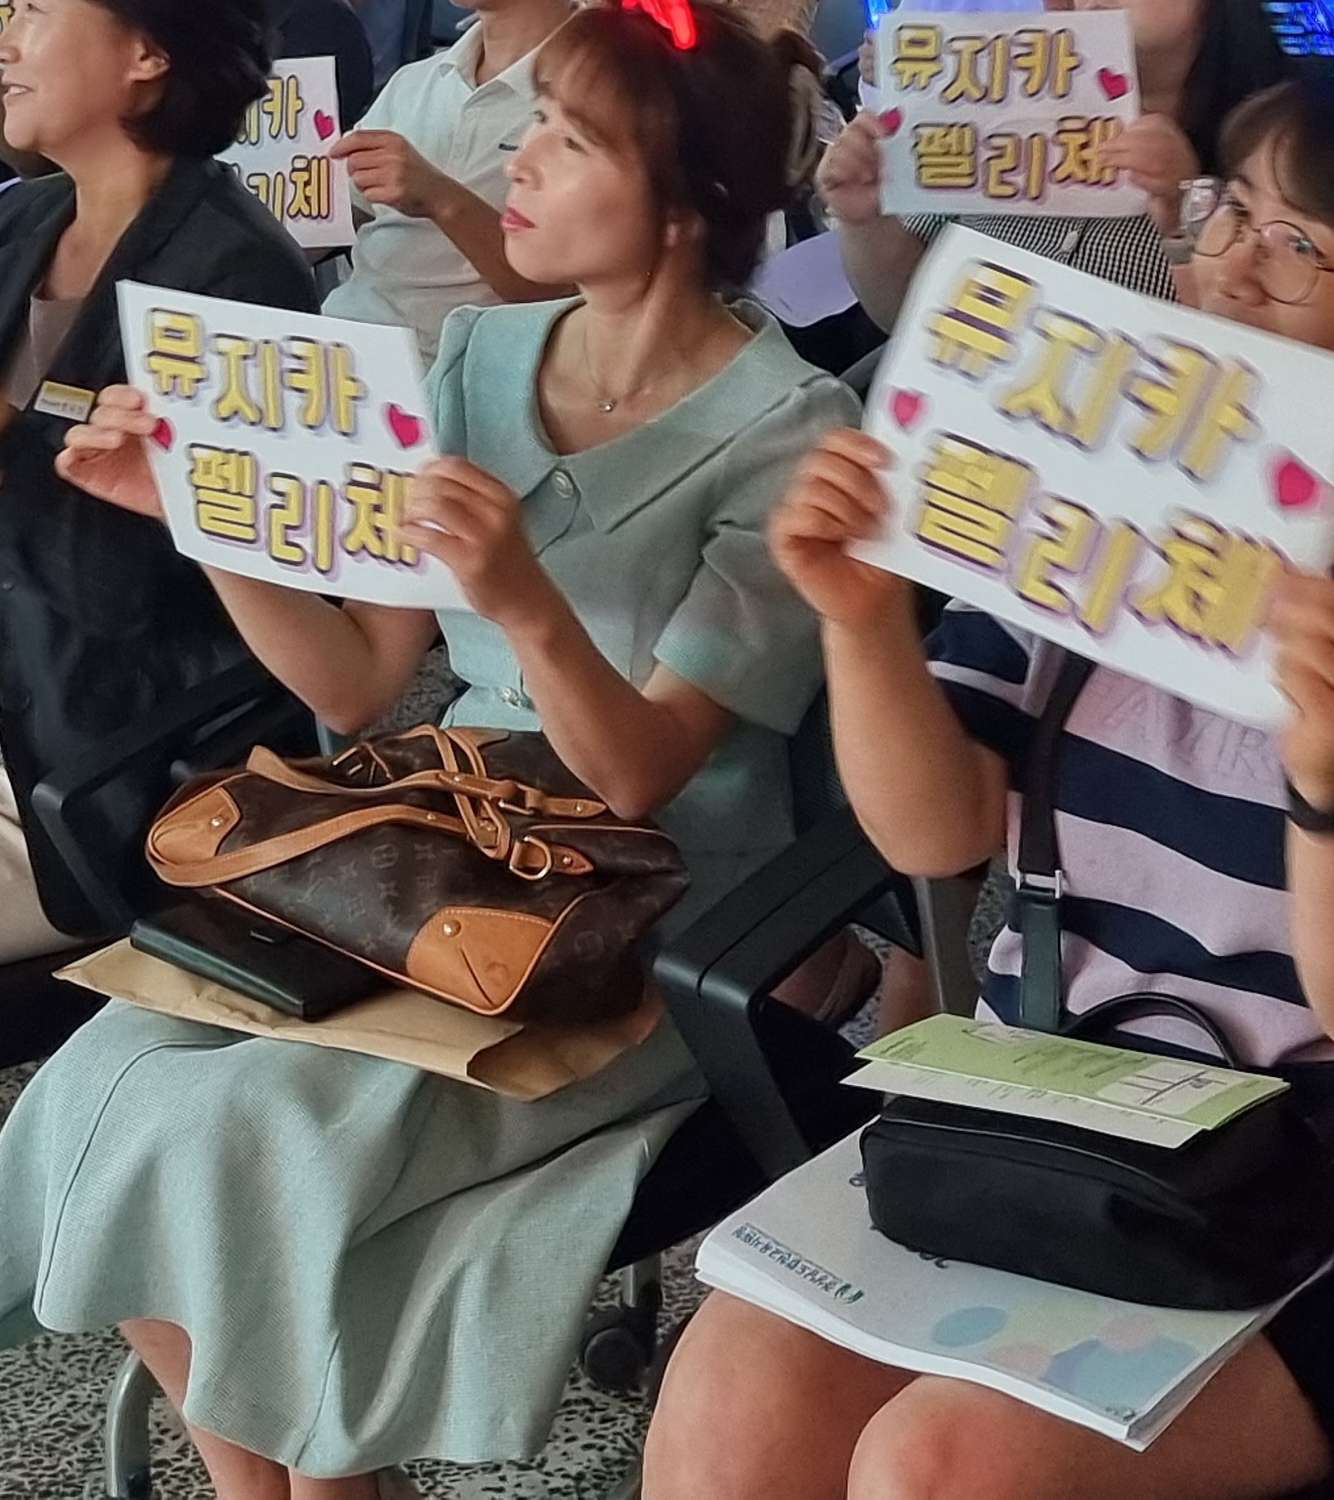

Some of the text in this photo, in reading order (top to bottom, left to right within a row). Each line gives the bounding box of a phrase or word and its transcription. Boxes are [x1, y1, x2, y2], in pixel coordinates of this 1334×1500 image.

[890, 24, 1083, 103] 뮤지카
[244, 155, 331, 222] 리체
[911, 114, 1120, 200] 펠리체
[144, 307, 365, 436] 뮤지카
[927, 257, 1261, 484] 뮤지카
[187, 441, 418, 573] 펠리체
[913, 430, 1291, 658] 펠리체
